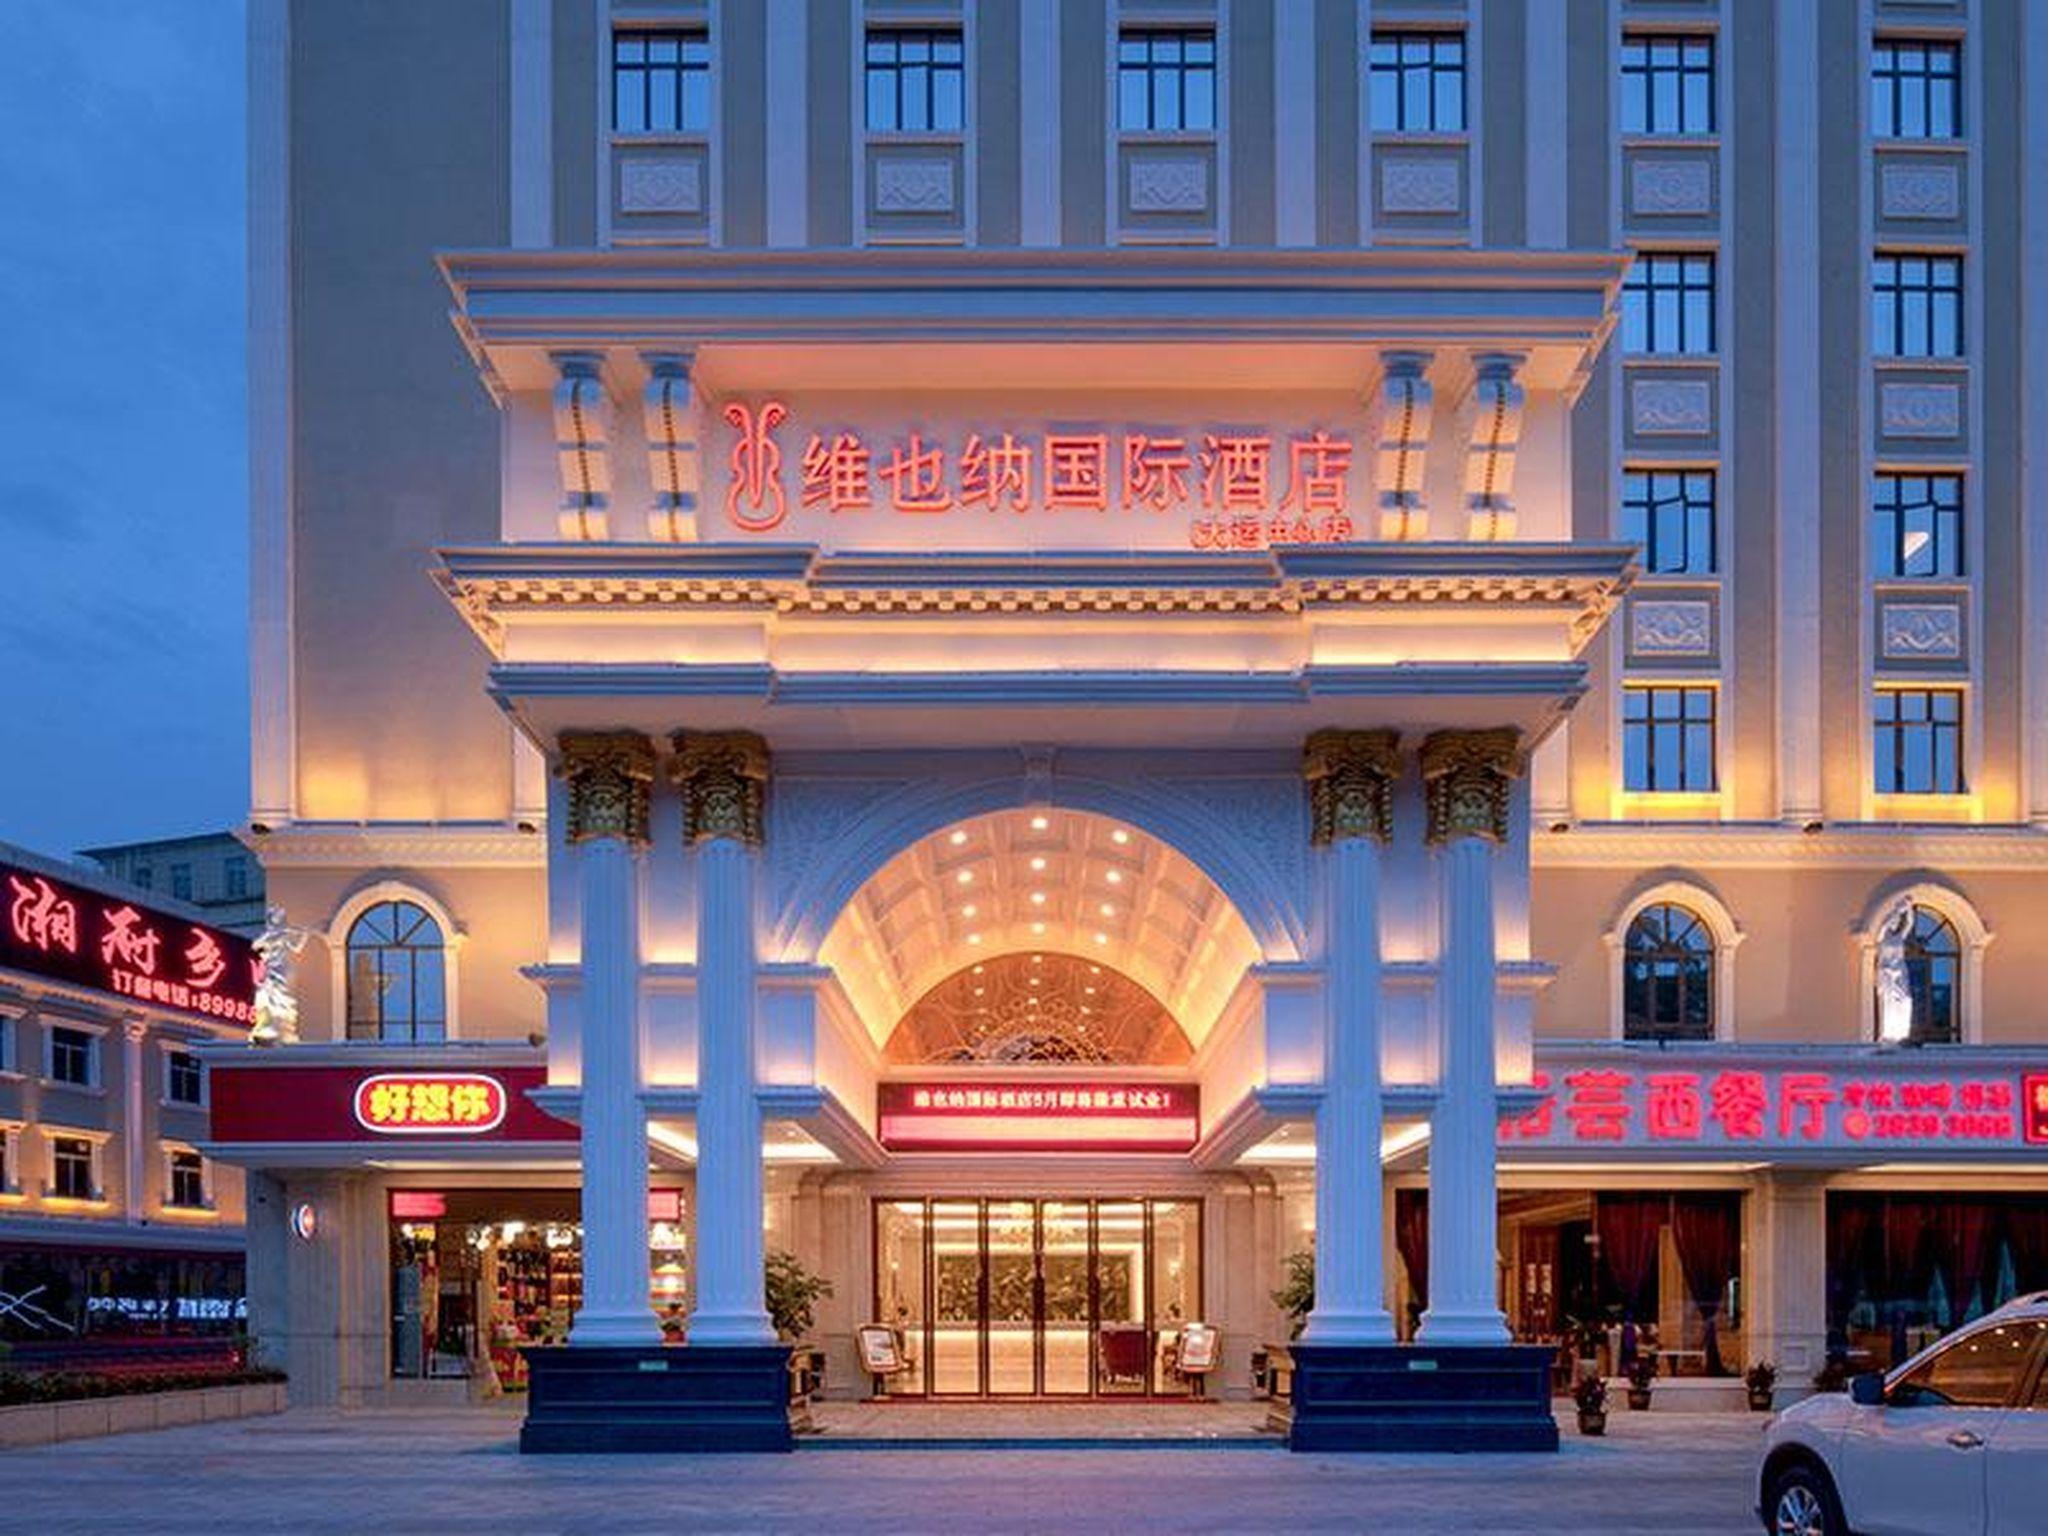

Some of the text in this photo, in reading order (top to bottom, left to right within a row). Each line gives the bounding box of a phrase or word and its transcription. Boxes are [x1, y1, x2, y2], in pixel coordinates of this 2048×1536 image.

[803, 432, 1353, 512] 维也纳国际酒店
[370, 1084, 492, 1123] 好想你
